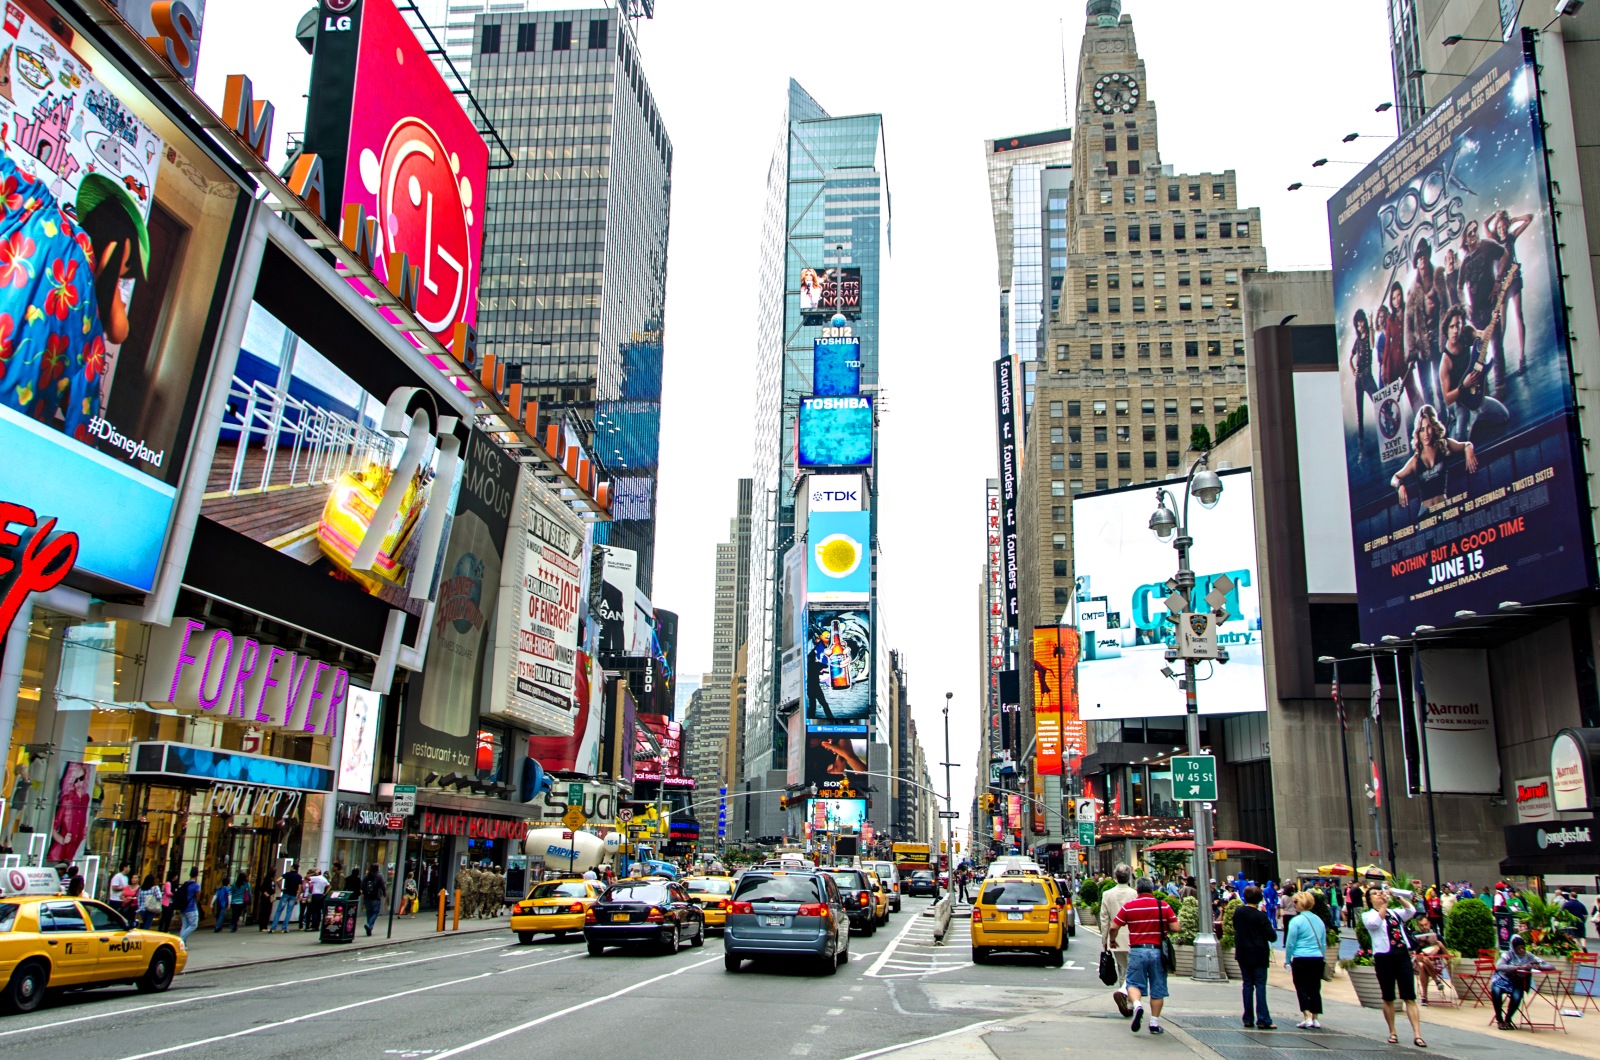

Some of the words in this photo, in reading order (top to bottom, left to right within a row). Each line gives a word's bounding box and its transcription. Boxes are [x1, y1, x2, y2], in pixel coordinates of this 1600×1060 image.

[325, 17, 351, 31] LG
[1423, 96, 1453, 127] HAIRSPRAY
[1457, 91, 1471, 111] PAUL
[1377, 150, 1479, 249] ROCK
[822, 290, 837, 298] ON
[823, 297, 858, 307] NOW
[815, 337, 860, 346] TOSHIBA
[822, 327, 852, 337] 2012
[1000, 360, 1011, 415] f.ounders
[1374, 387, 1392, 403] FILTH
[803, 398, 869, 409] TOSHIBA
[87, 415, 164, 468] #Disneyland
[1382, 444, 1407, 460] STACEE
[1384, 436, 1402, 449] JAXX
[1003, 444, 1014, 500] f.ounders
[463, 459, 511, 518] AMOUS
[823, 490, 858, 502] TDK
[1474, 487, 1507, 508] SPEEDWAGON
[1512, 475, 1535, 493] TWISTED
[1535, 466, 1555, 483] SISTER
[527, 508, 571, 555] NEWSIES
[1391, 553, 1429, 577] NOTHIN'
[1431, 545, 1449, 563] BUT
[1450, 542, 1459, 556] A
[1461, 527, 1497, 551] GOOD
[1498, 516, 1525, 538] TIME
[1007, 534, 1017, 590] f.ounders
[1428, 555, 1466, 585] JUNE
[1467, 549, 1485, 571] 15
[1458, 570, 1482, 585] IMAX
[559, 578, 580, 614] JOLT
[529, 596, 539, 620] OF
[1081, 612, 1097, 621] CMT
[520, 631, 554, 660] HIGH-ENERGY
[167, 617, 350, 738] FOREVER
[645, 657, 653, 693] 1500
[1426, 702, 1480, 716] Marriott
[411, 742, 450, 761] restaurant
[458, 751, 470, 766] bar
[1187, 761, 1199, 770] To
[1556, 764, 1579, 779] Marriott
[1175, 773, 1184, 782] W
[1187, 773, 1200, 782] 45
[1202, 772, 1213, 782] St
[207, 783, 283, 818] FOREVER
[1517, 782, 1549, 803] Marriott
[424, 812, 467, 835] PLANET
[469, 816, 528, 841] HOLLYWOOD
[545, 844, 581, 860] EMPIRE
[109, 943, 121, 952] NYC
